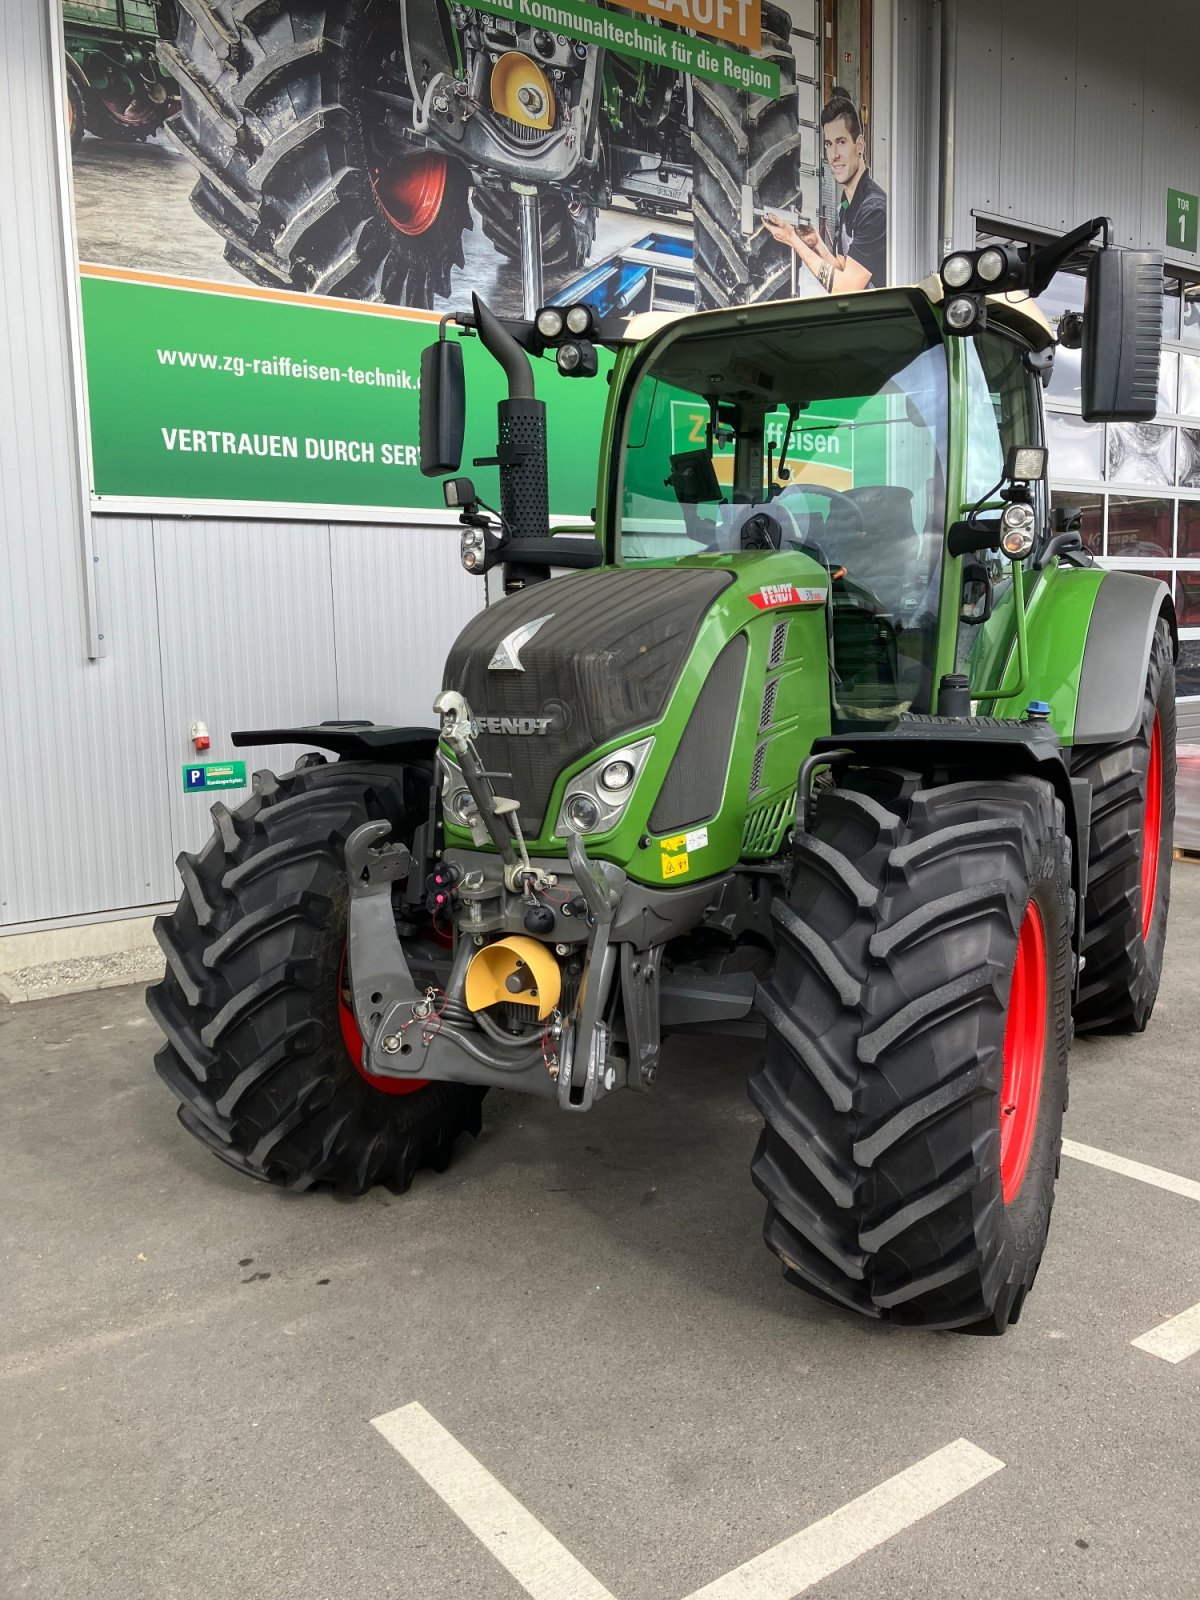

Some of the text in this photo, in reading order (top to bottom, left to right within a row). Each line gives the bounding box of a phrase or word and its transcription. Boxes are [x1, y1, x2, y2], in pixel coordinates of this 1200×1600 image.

[648, 0, 752, 37] UFT
[483, 0, 771, 89] nd Kommunaltechnik für die Region
[1177, 198, 1190, 211] TOR
[1178, 214, 1186, 243] 1
[161, 427, 298, 458] VERTRAUEN
[305, 438, 374, 463] DURCH
[767, 422, 840, 454] ffeisen
[760, 583, 792, 605] FENDT
[474, 717, 553, 735] FENDT
[191, 770, 200, 783] P
